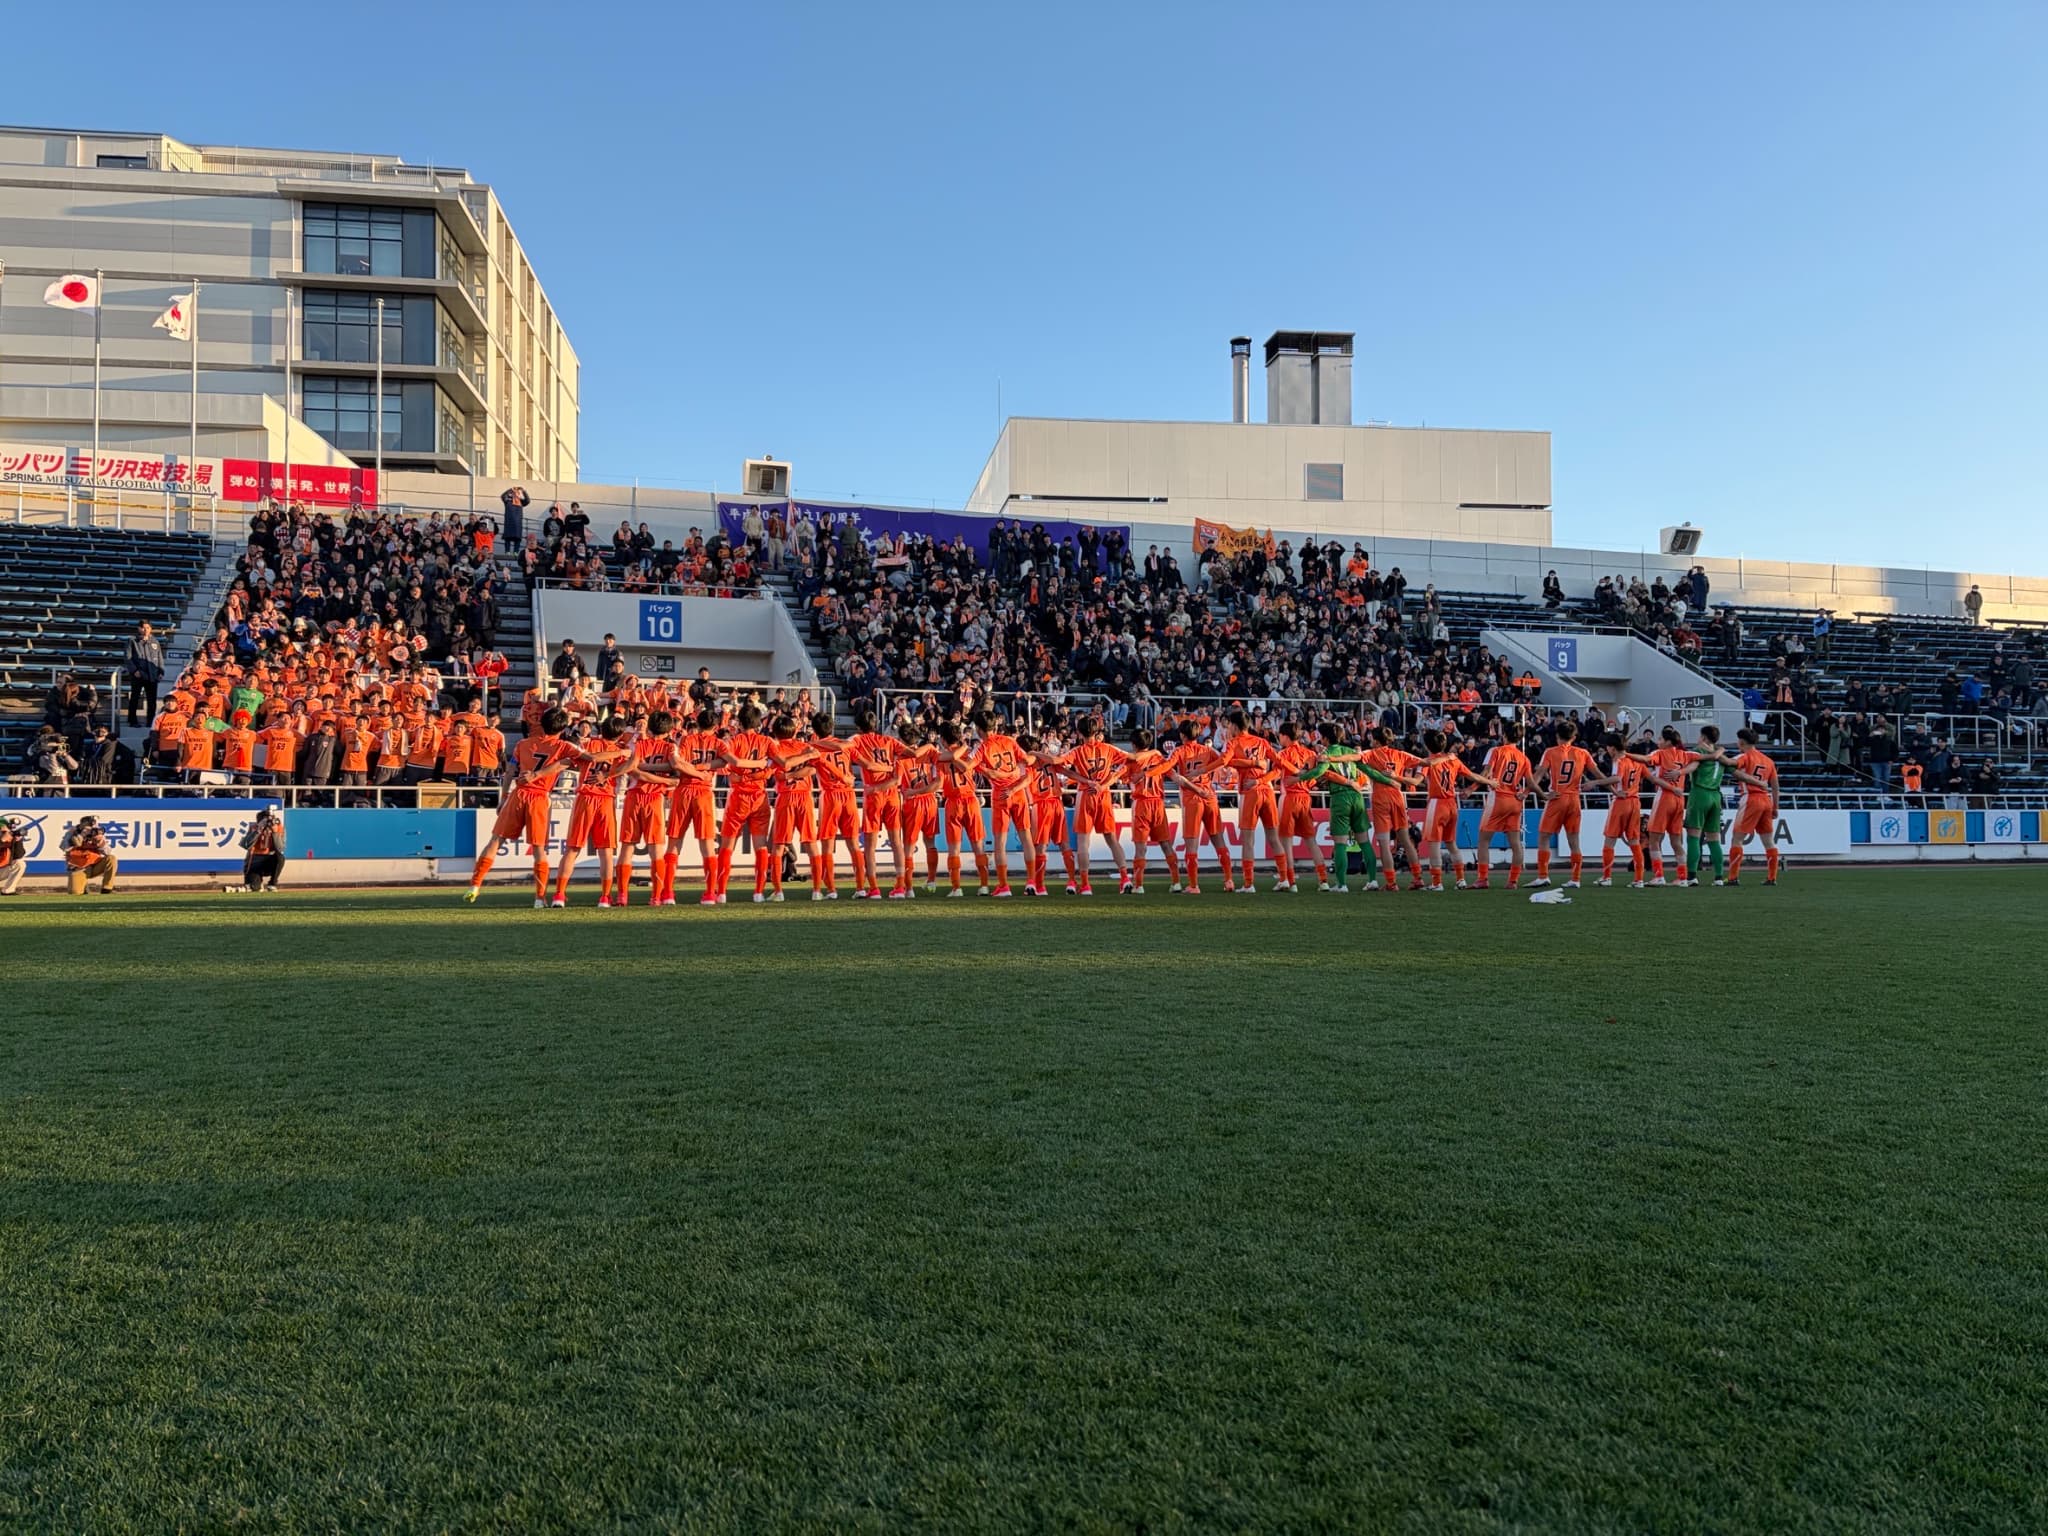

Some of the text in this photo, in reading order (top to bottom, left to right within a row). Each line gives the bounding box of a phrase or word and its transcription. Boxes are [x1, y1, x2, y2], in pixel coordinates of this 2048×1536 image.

[0, 452, 64, 473] ッパツ
[3, 472, 42, 482] SPRING
[110, 479, 161, 491] FOOTBALL
[649, 604, 673, 614] バック
[647, 616, 674, 638] 10
[1558, 651, 1568, 669] 9
[532, 753, 549, 772] 7
[992, 751, 1013, 772] 23
[1502, 761, 1518, 784] 8
[1557, 760, 1575, 785] 9
[1752, 765, 1766, 781] 5
